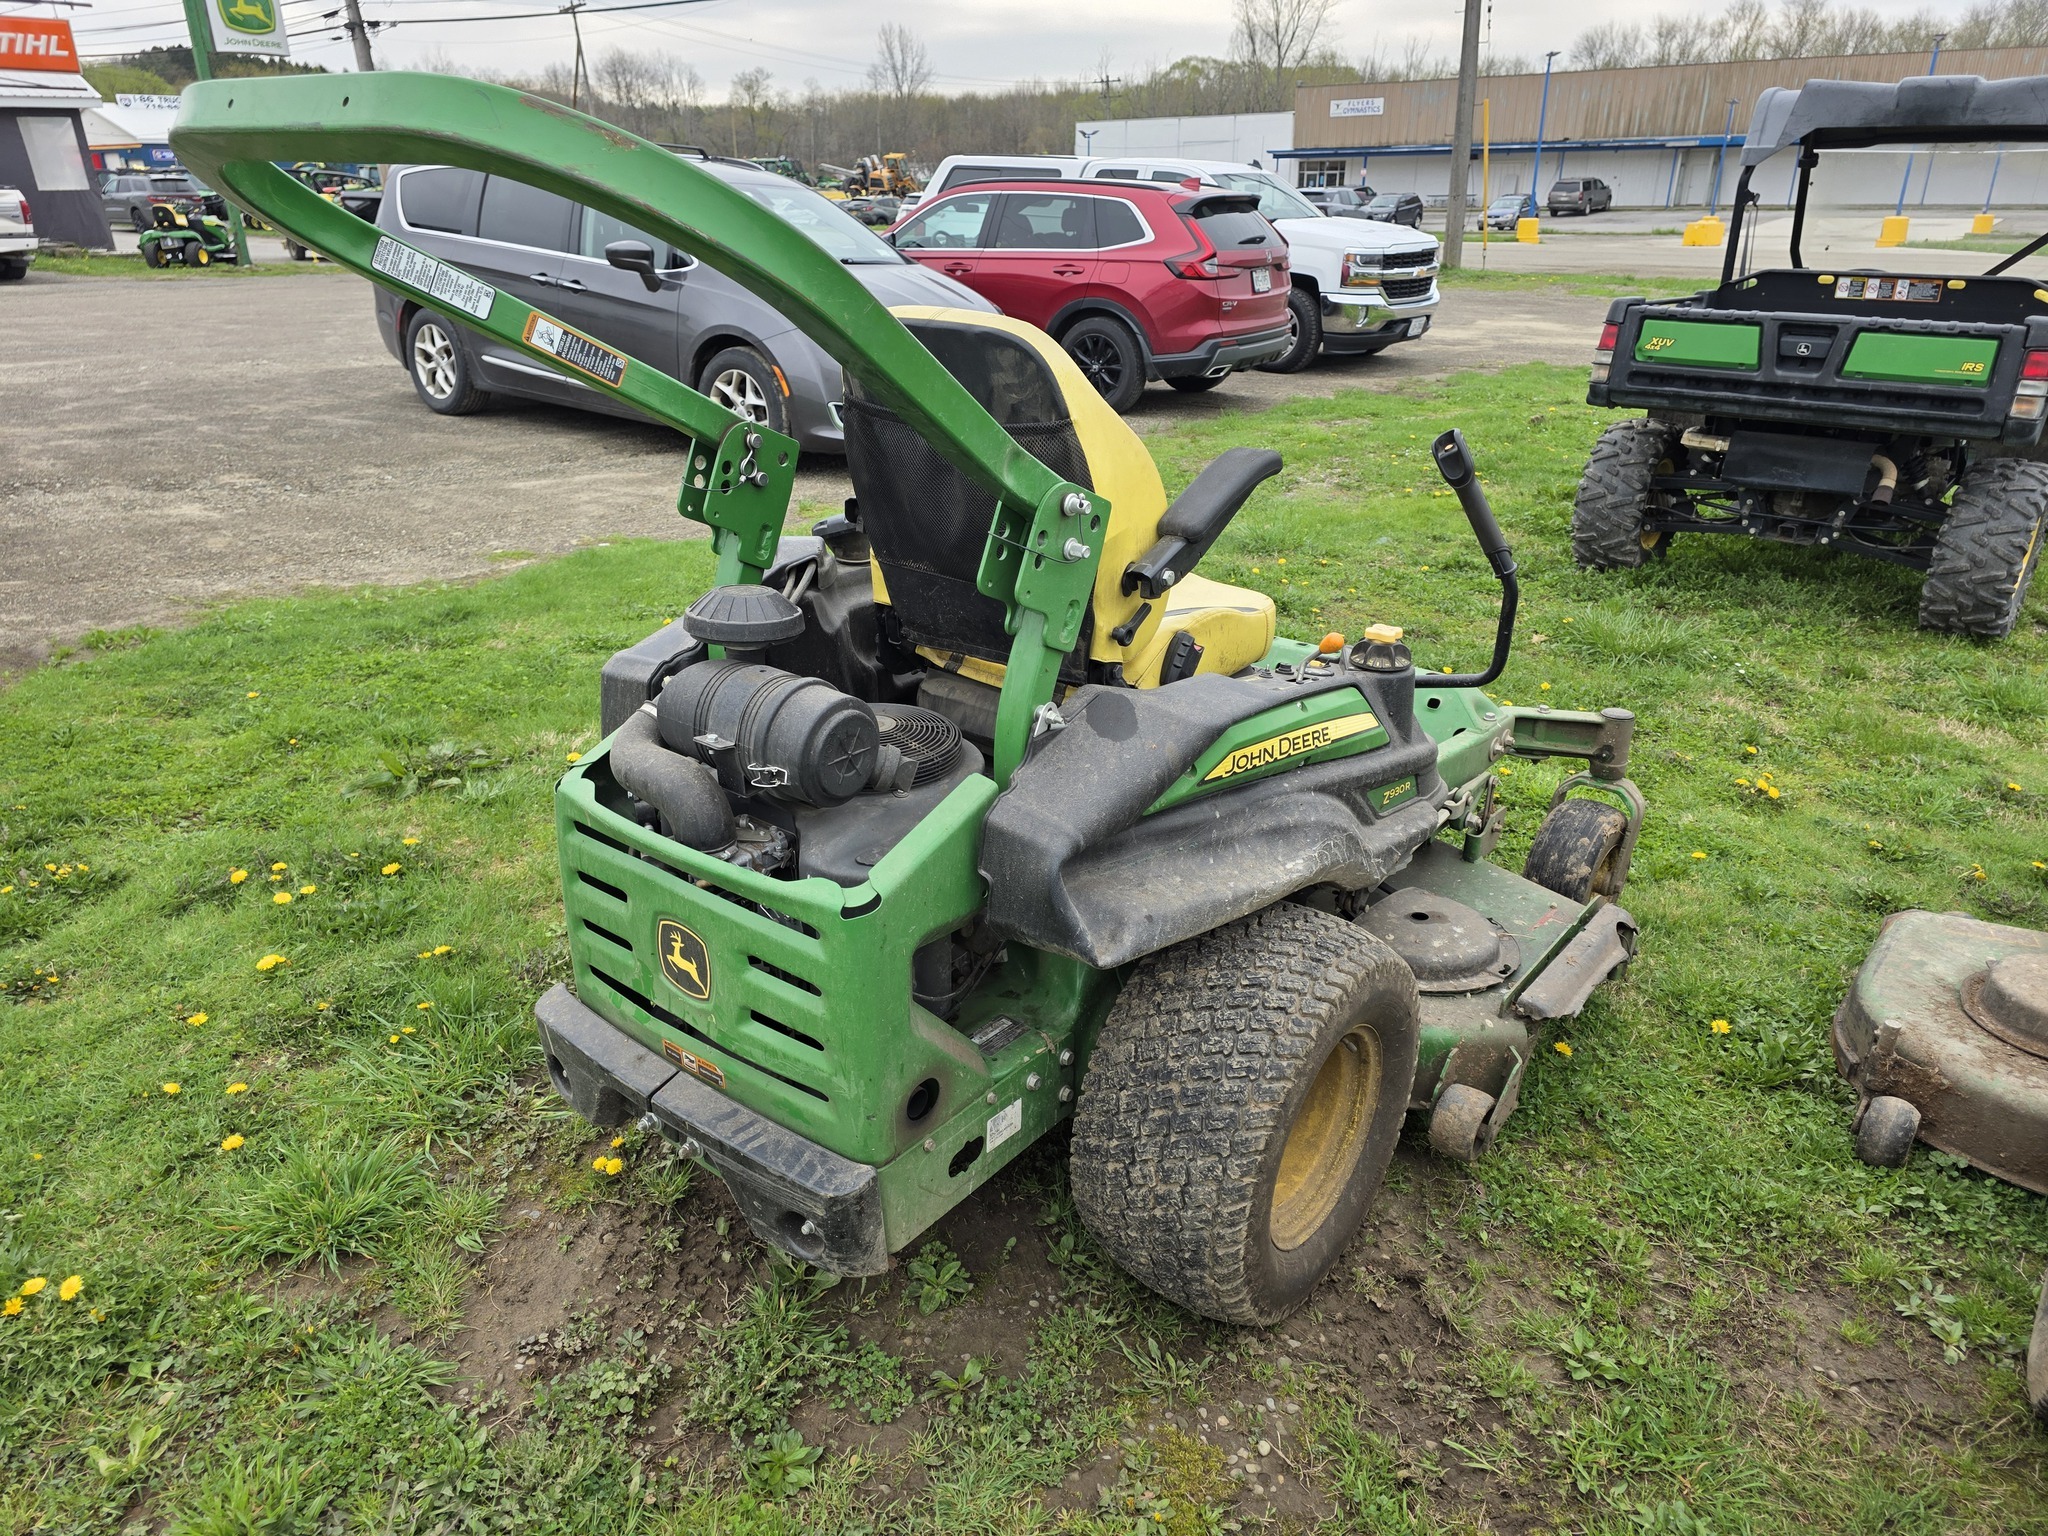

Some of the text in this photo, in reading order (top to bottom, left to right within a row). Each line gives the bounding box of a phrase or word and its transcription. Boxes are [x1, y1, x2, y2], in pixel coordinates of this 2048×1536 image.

[224, 36, 283, 49] JOHN DEERE
[1342, 105, 1381, 114] GYMNASTICS
[1650, 336, 1676, 347] XUV
[1644, 343, 1661, 351] 4x4
[1960, 362, 1985, 372] IRS
[1225, 726, 1332, 774] JOHN DEERE
